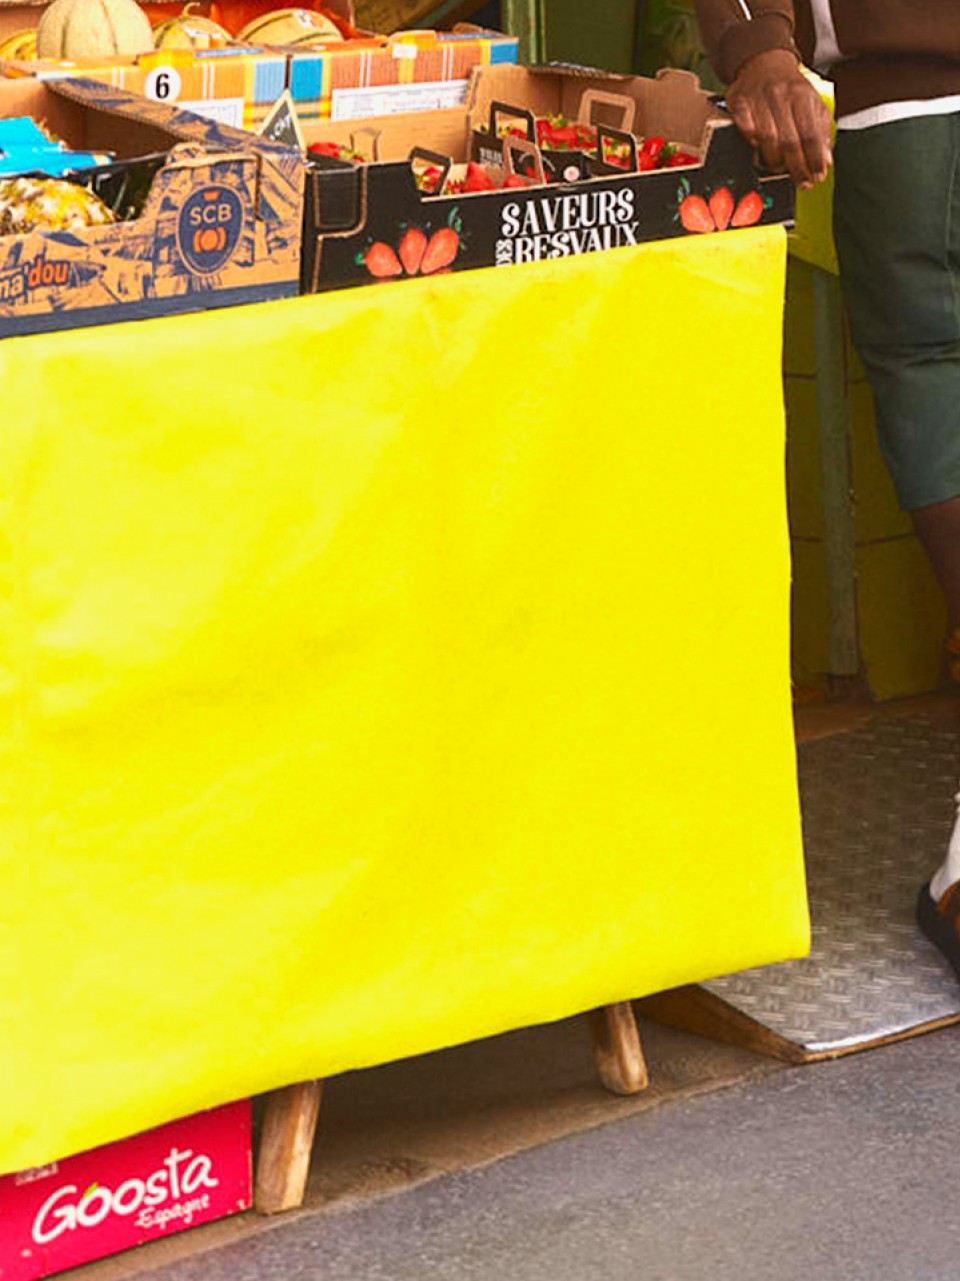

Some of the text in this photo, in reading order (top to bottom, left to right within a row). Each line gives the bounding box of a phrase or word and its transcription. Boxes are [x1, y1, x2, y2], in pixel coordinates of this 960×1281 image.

[155, 73, 170, 99] 6
[189, 203, 233, 226] SCB
[501, 187, 635, 238] SAVEURS
[32, 1147, 219, 1244] Goosta
